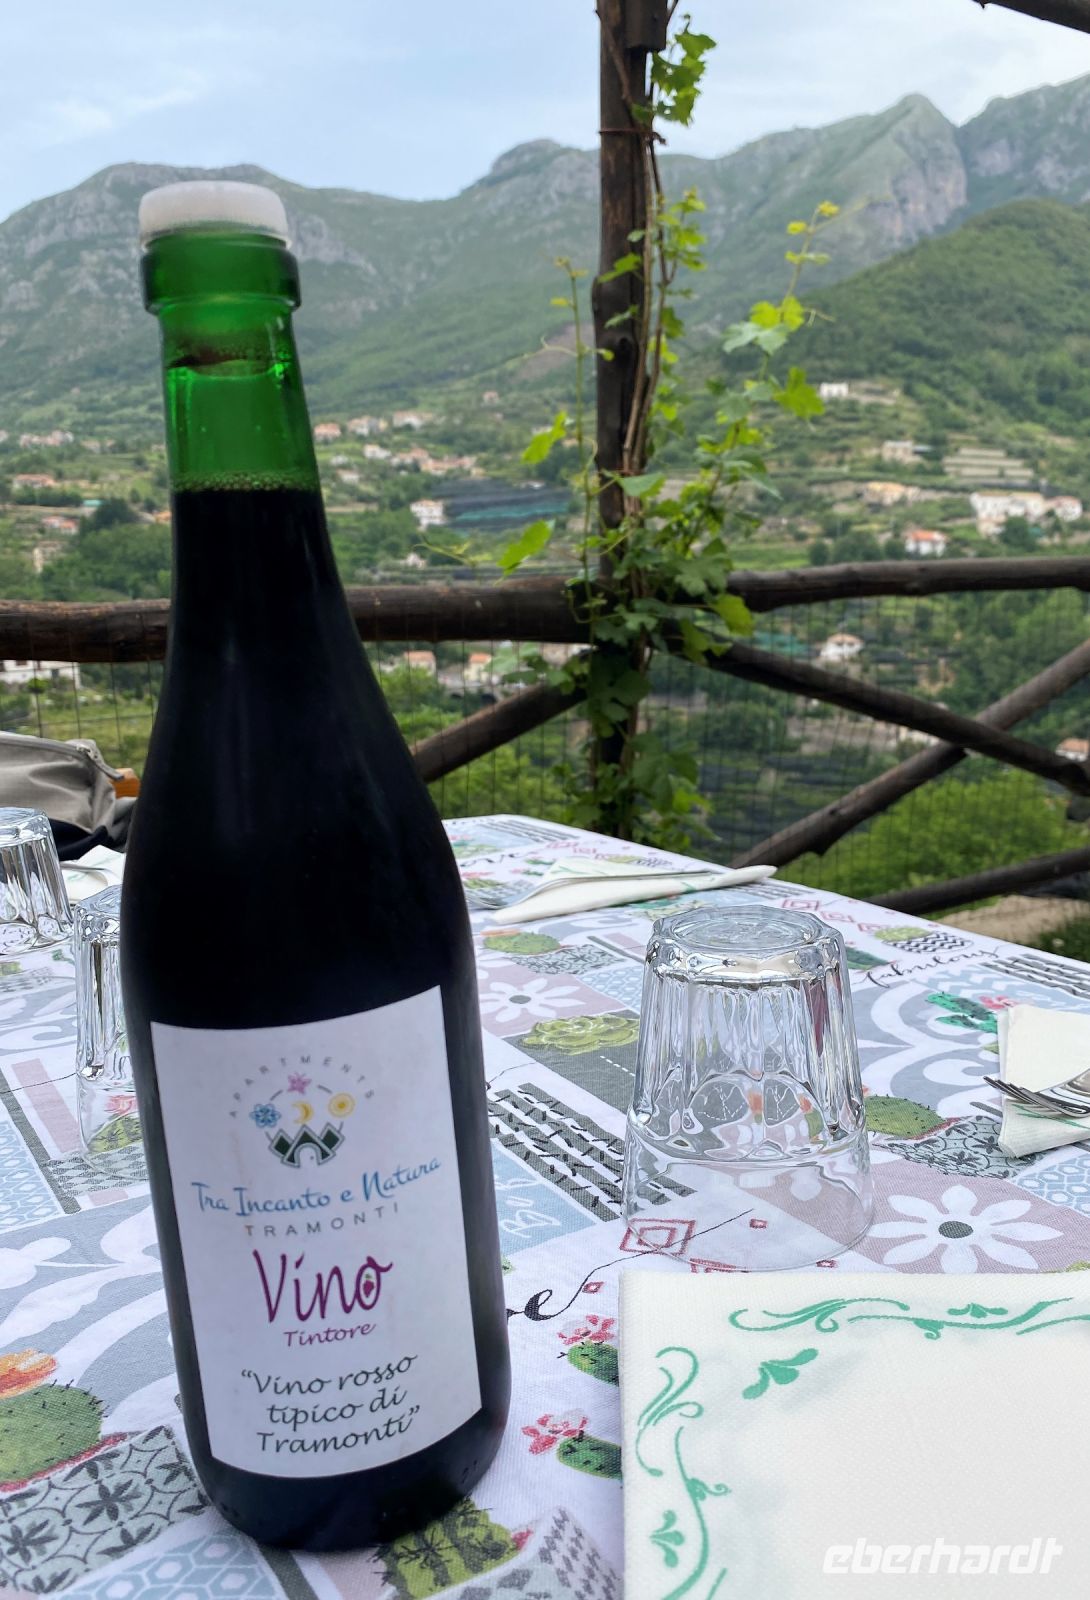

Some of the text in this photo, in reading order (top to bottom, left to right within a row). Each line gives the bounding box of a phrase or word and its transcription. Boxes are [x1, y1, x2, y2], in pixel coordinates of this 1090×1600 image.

[229, 1055, 375, 1118] APARTMENTS
[191, 1157, 442, 1217] Tra Incanto e Natura
[246, 1203, 398, 1237] TRAMONTI
[252, 1249, 394, 1324] Vino
[283, 1322, 377, 1348] Tintore
[338, 1353, 419, 1391] rosso
[267, 1385, 407, 1433] tipico di
